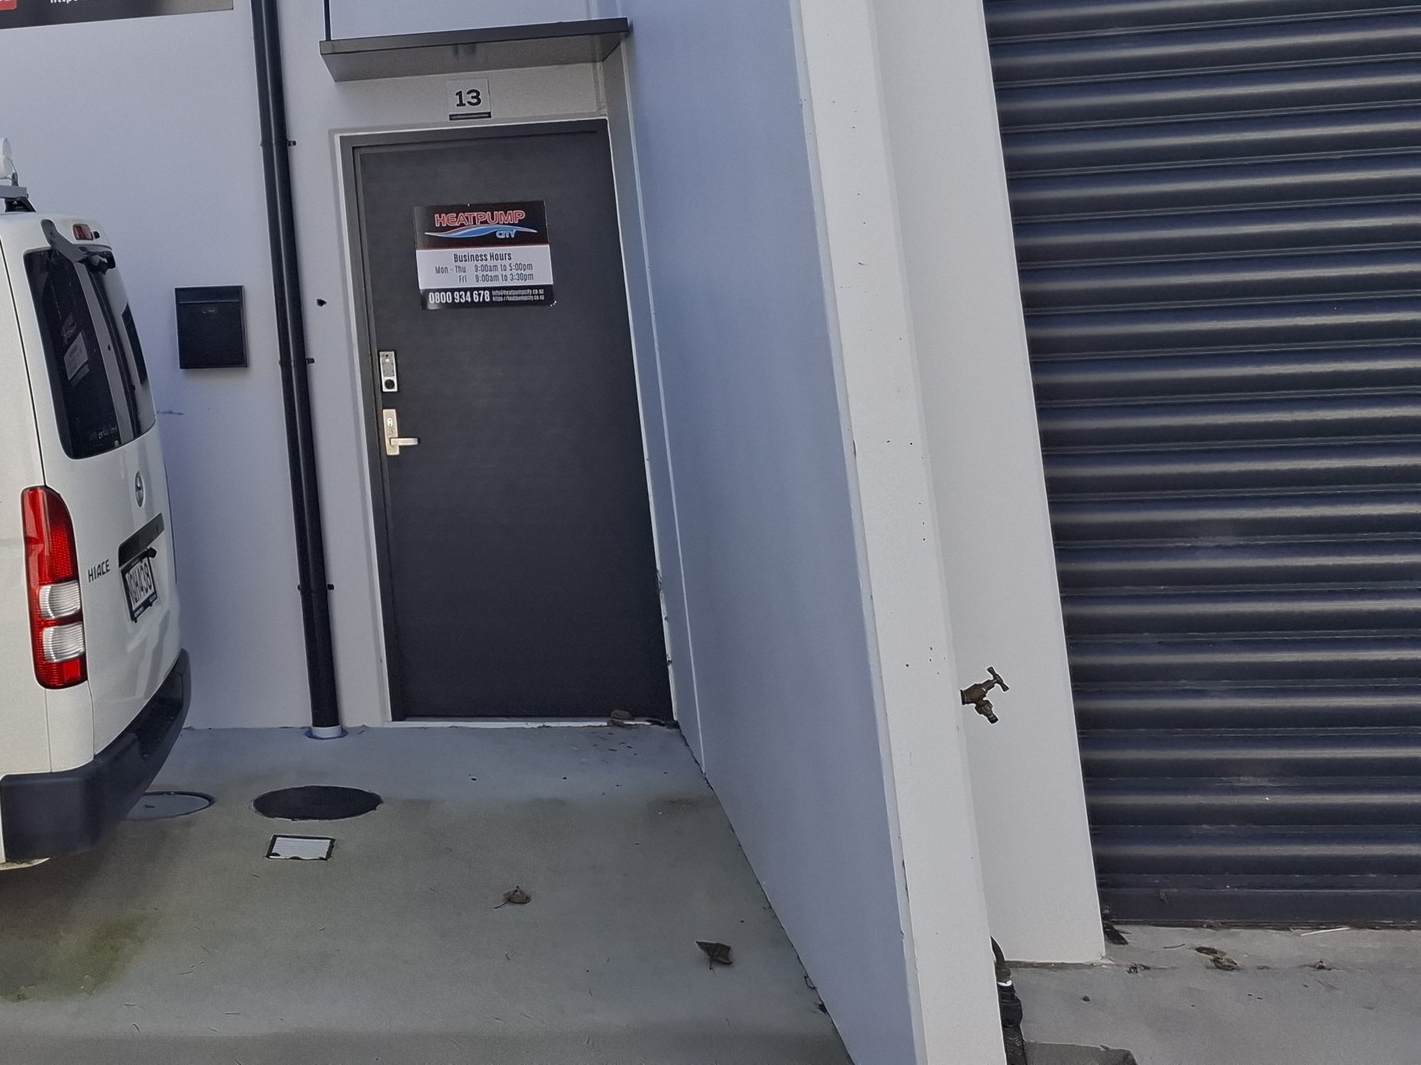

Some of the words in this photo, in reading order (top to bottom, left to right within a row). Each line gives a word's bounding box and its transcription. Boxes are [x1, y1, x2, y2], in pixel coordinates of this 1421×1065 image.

[455, 88, 482, 107] 13
[434, 210, 526, 227] HEATPUMP
[495, 229, 517, 239] CITY
[453, 253, 488, 263] Business
[489, 252, 512, 262] Hours
[434, 265, 449, 274] Mon
[455, 265, 466, 273] Thu
[500, 263, 507, 271] to
[459, 275, 467, 283] Fri
[501, 273, 508, 282] to
[428, 292, 452, 304] 0800
[454, 291, 471, 303] 934
[473, 290, 490, 302] 678
[87, 559, 110, 582] HIACE
